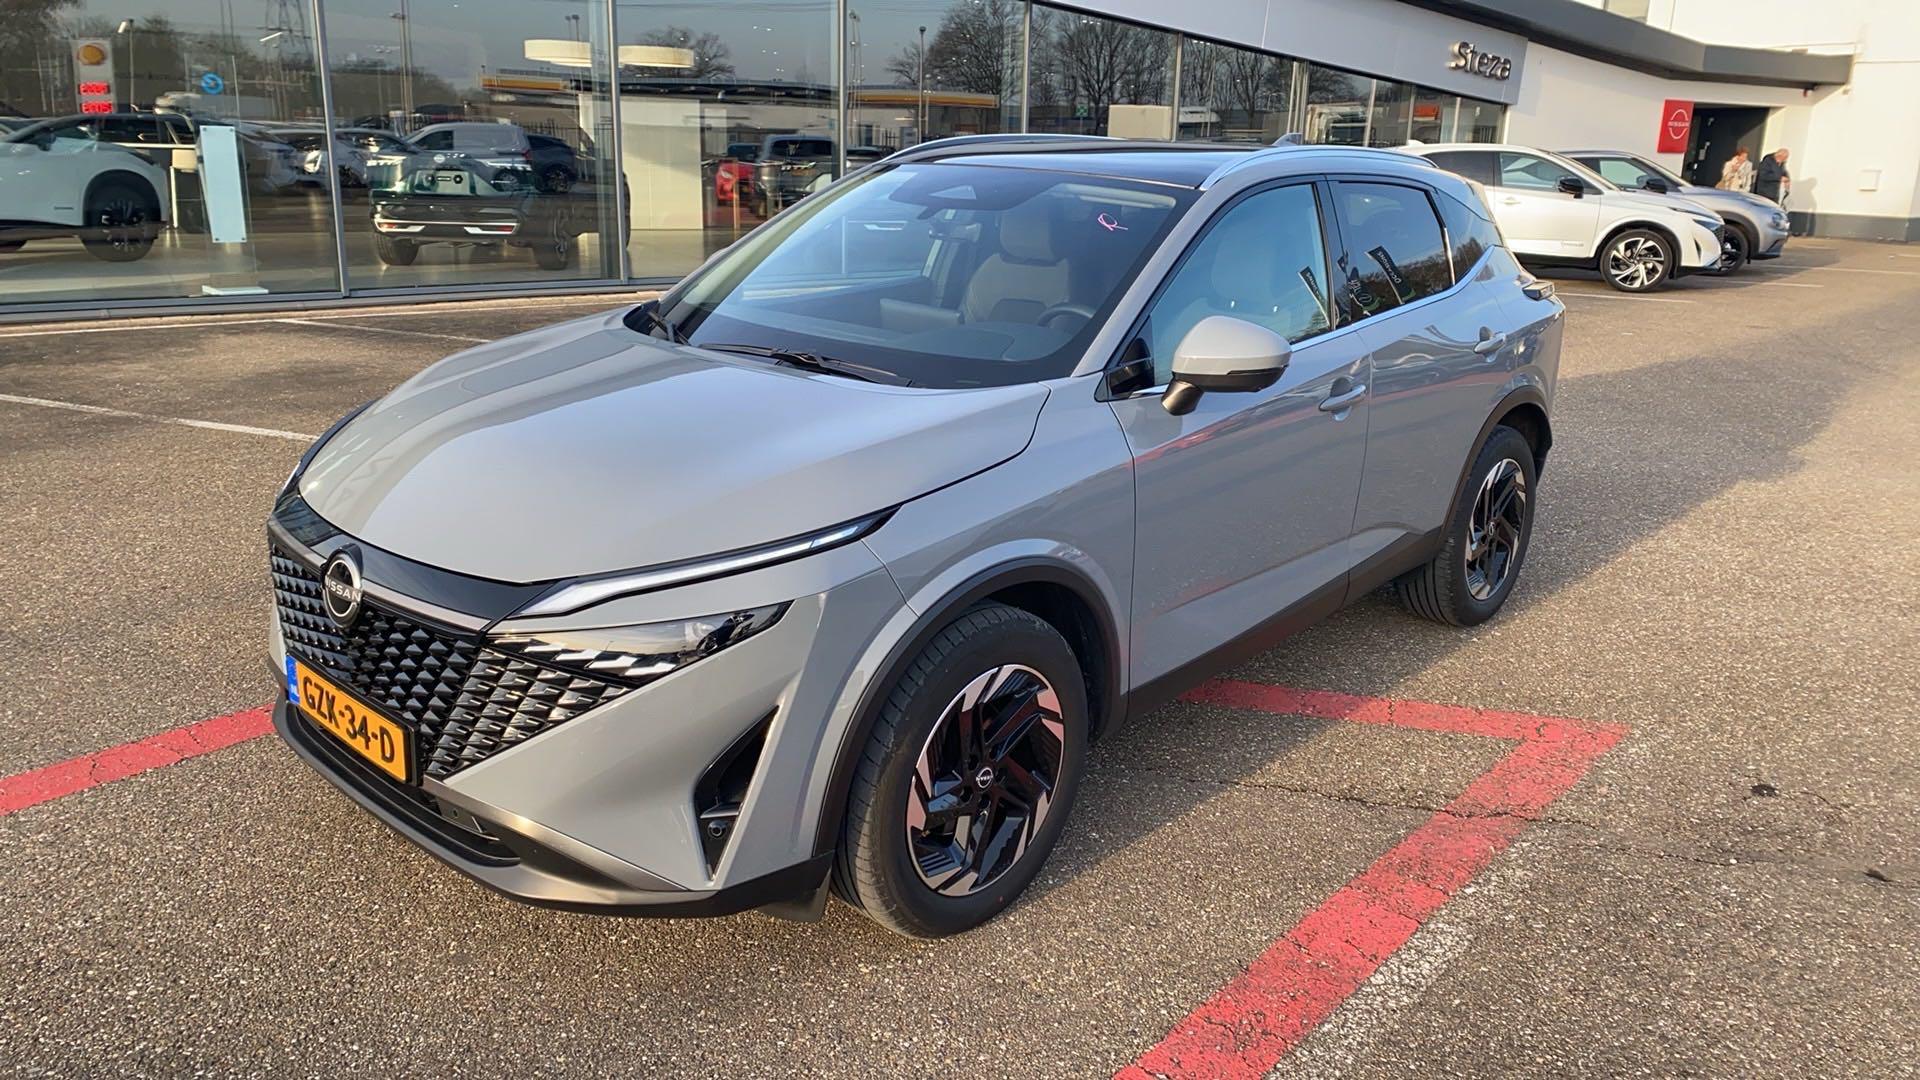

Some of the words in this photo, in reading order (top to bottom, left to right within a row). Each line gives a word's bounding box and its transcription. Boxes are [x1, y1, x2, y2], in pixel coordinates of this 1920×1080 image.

[1446, 41, 1511, 80] Steza
[325, 575, 361, 602] NISSAN
[303, 675, 395, 763] GZK-34-D
